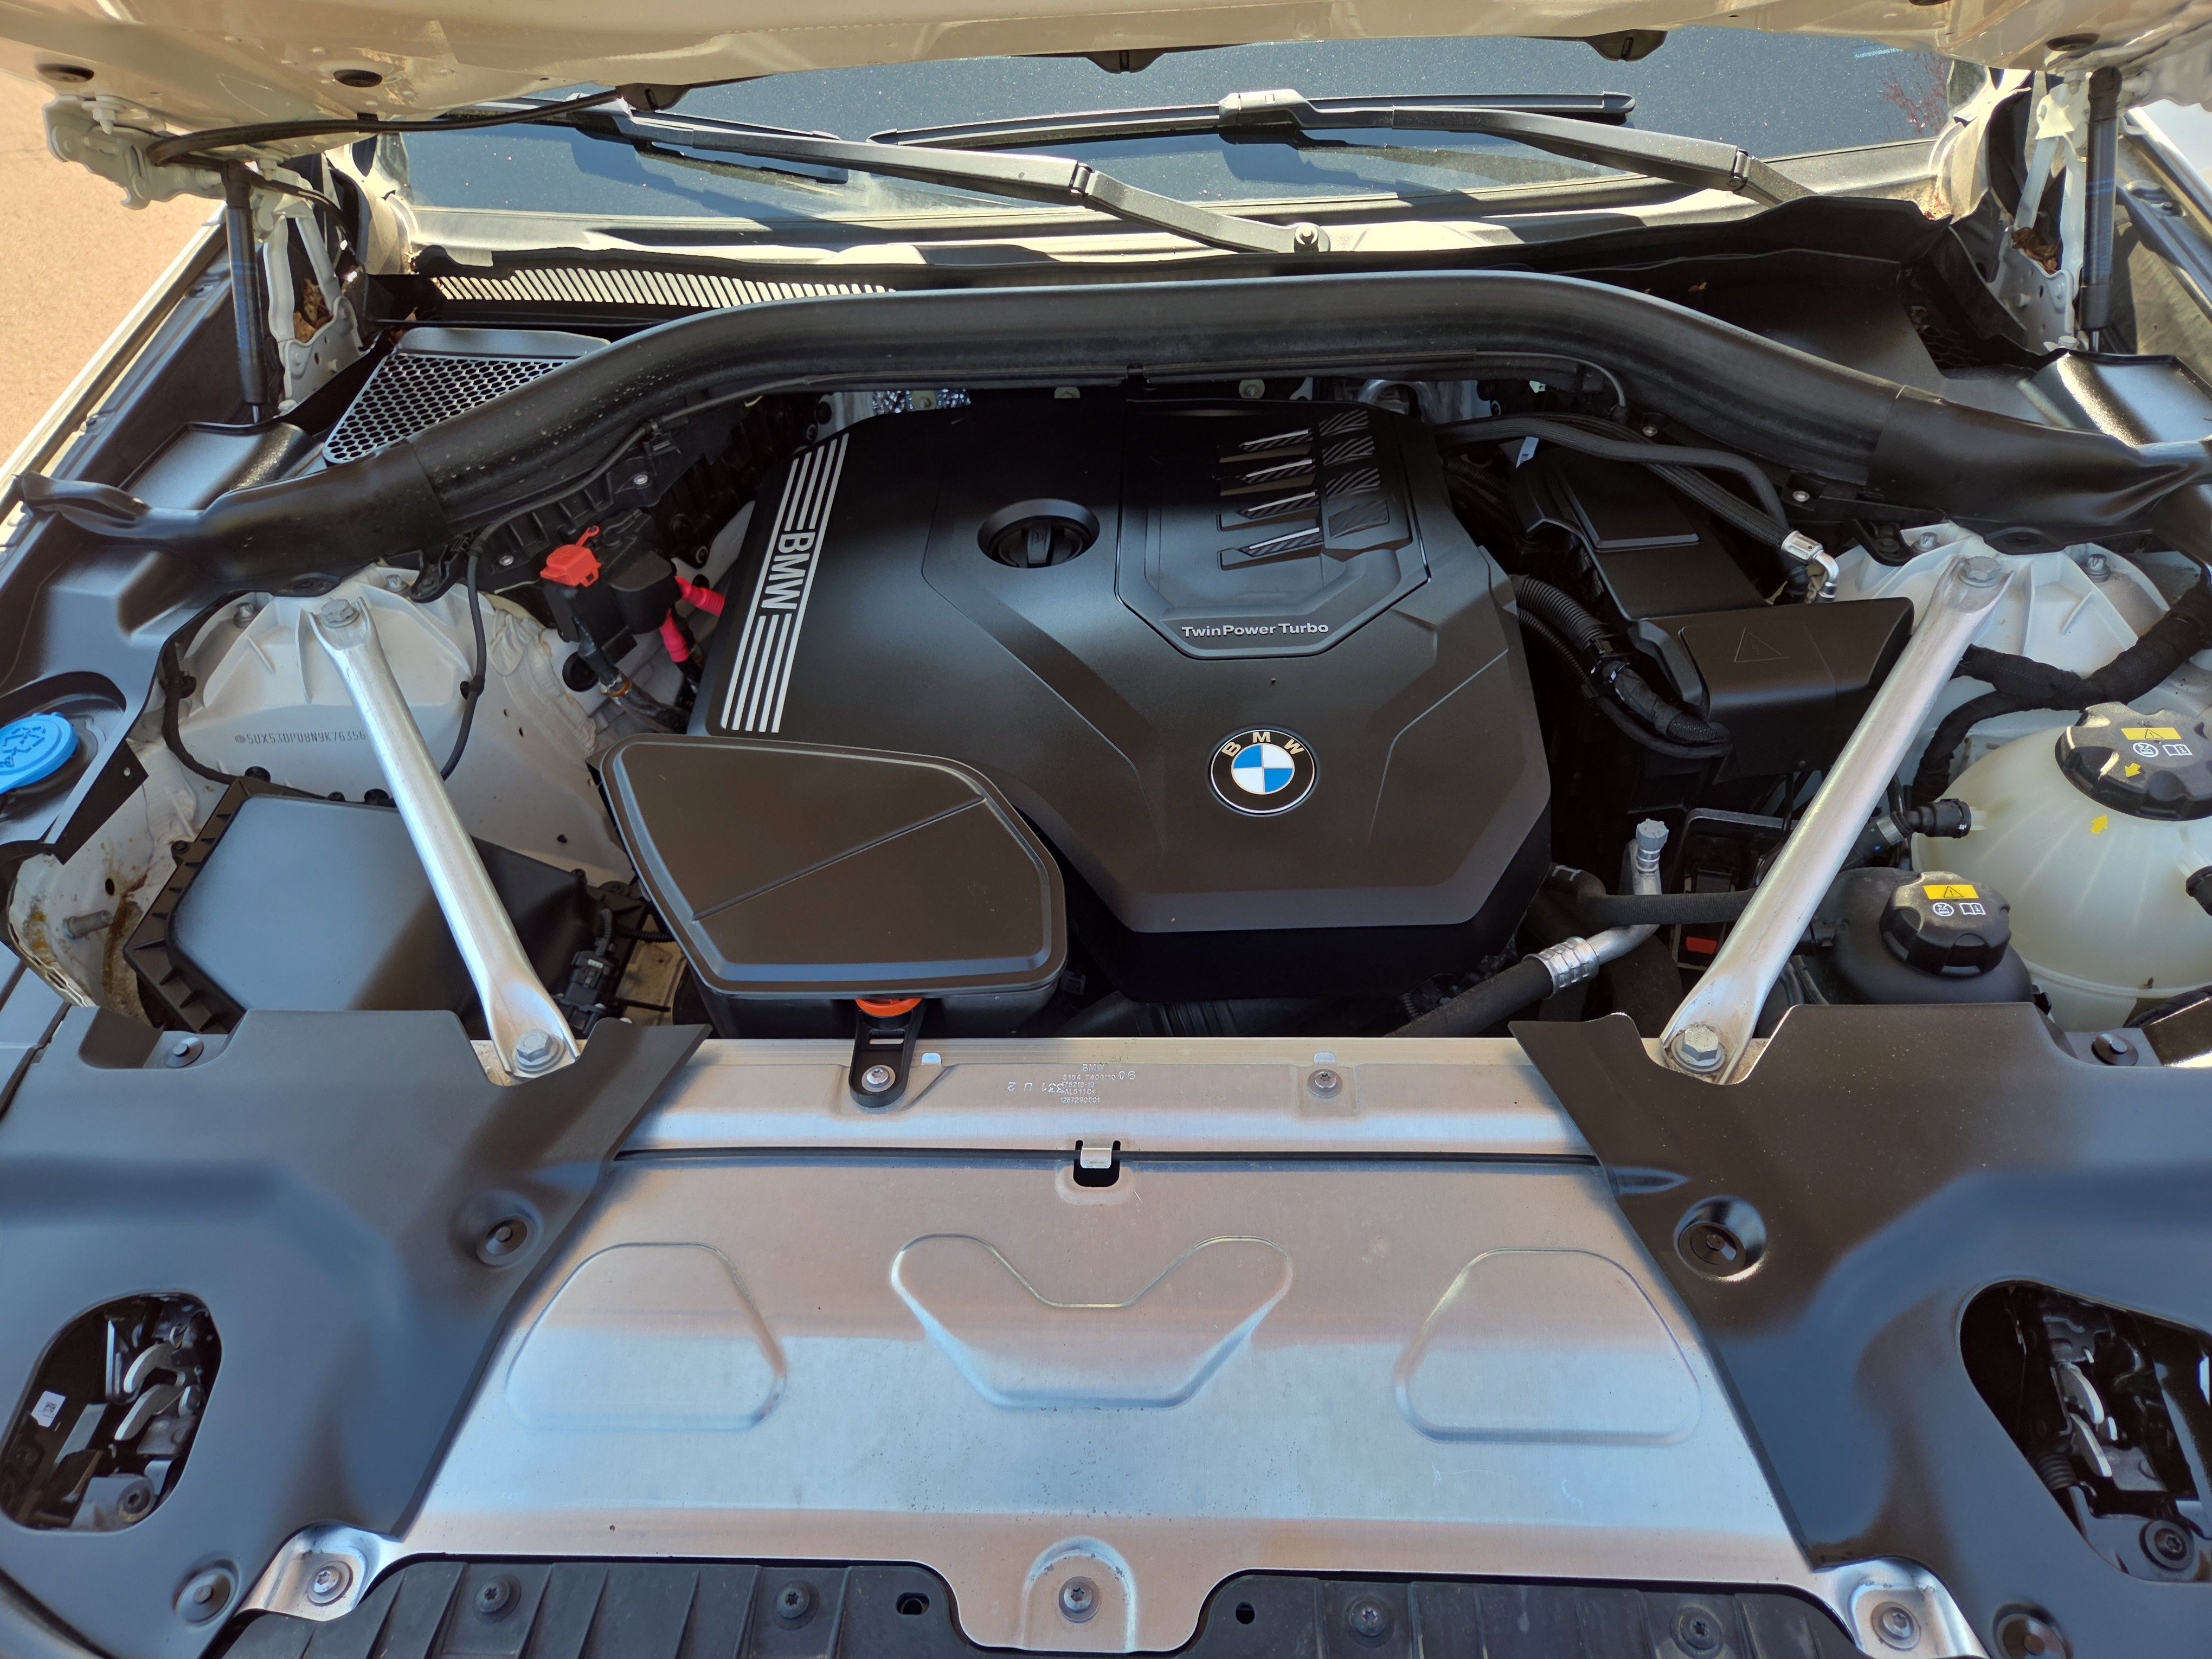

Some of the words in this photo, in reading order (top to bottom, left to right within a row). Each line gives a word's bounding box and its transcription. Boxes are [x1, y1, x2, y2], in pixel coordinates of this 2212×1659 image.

[761, 532, 815, 610] BMW
[1278, 622, 1329, 634] Turbo
[246, 730, 366, 745] 5UX53DP08N9K76356
[1221, 731, 1304, 757] BMW
[1082, 1063, 1105, 1072] BMW
